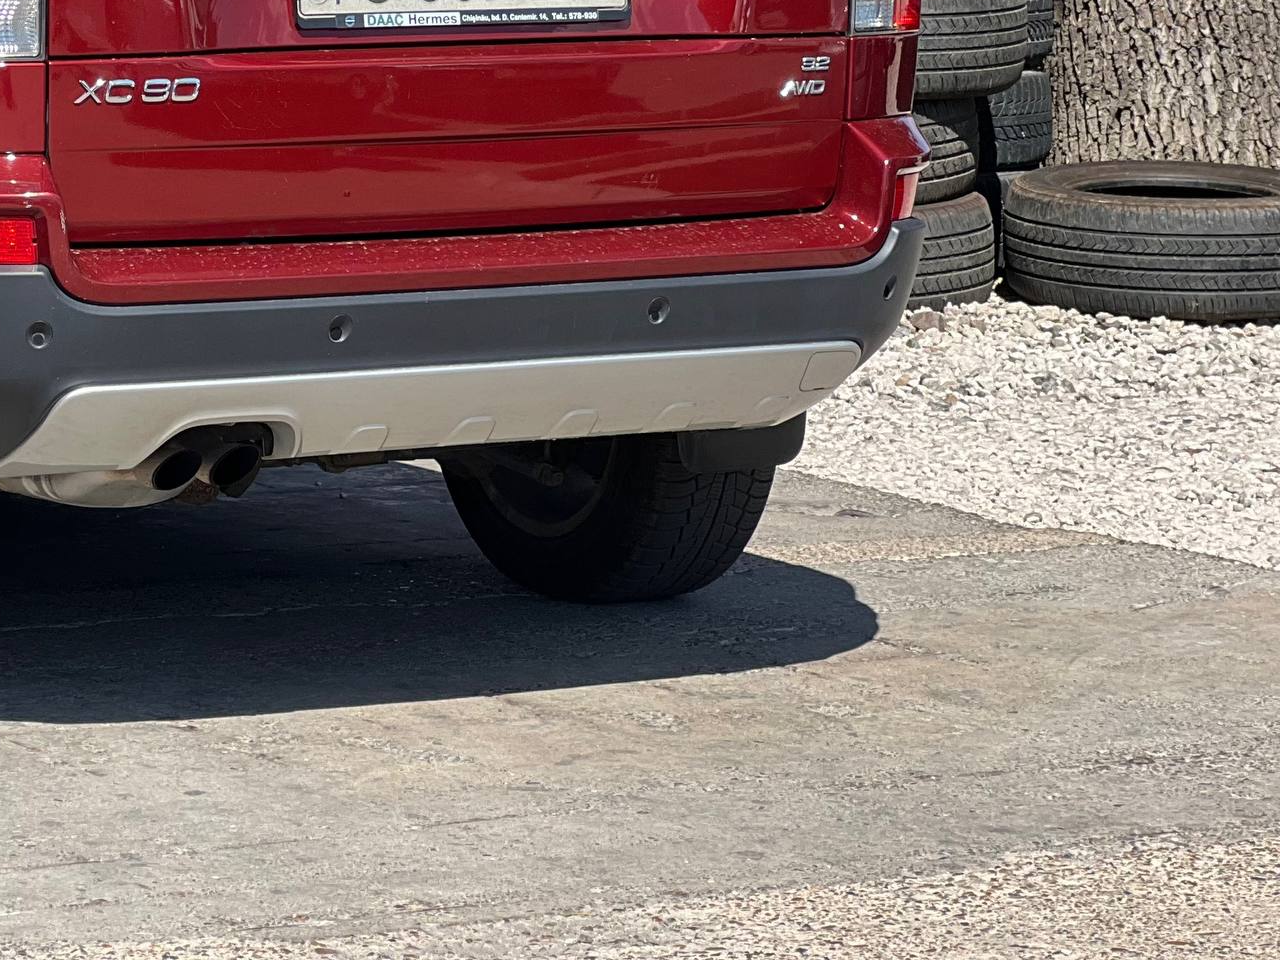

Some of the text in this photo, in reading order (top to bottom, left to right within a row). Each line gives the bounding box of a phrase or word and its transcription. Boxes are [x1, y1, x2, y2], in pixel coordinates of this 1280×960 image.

[367, 13, 458, 26] DAAC Hermes
[780, 79, 825, 97] AWD
